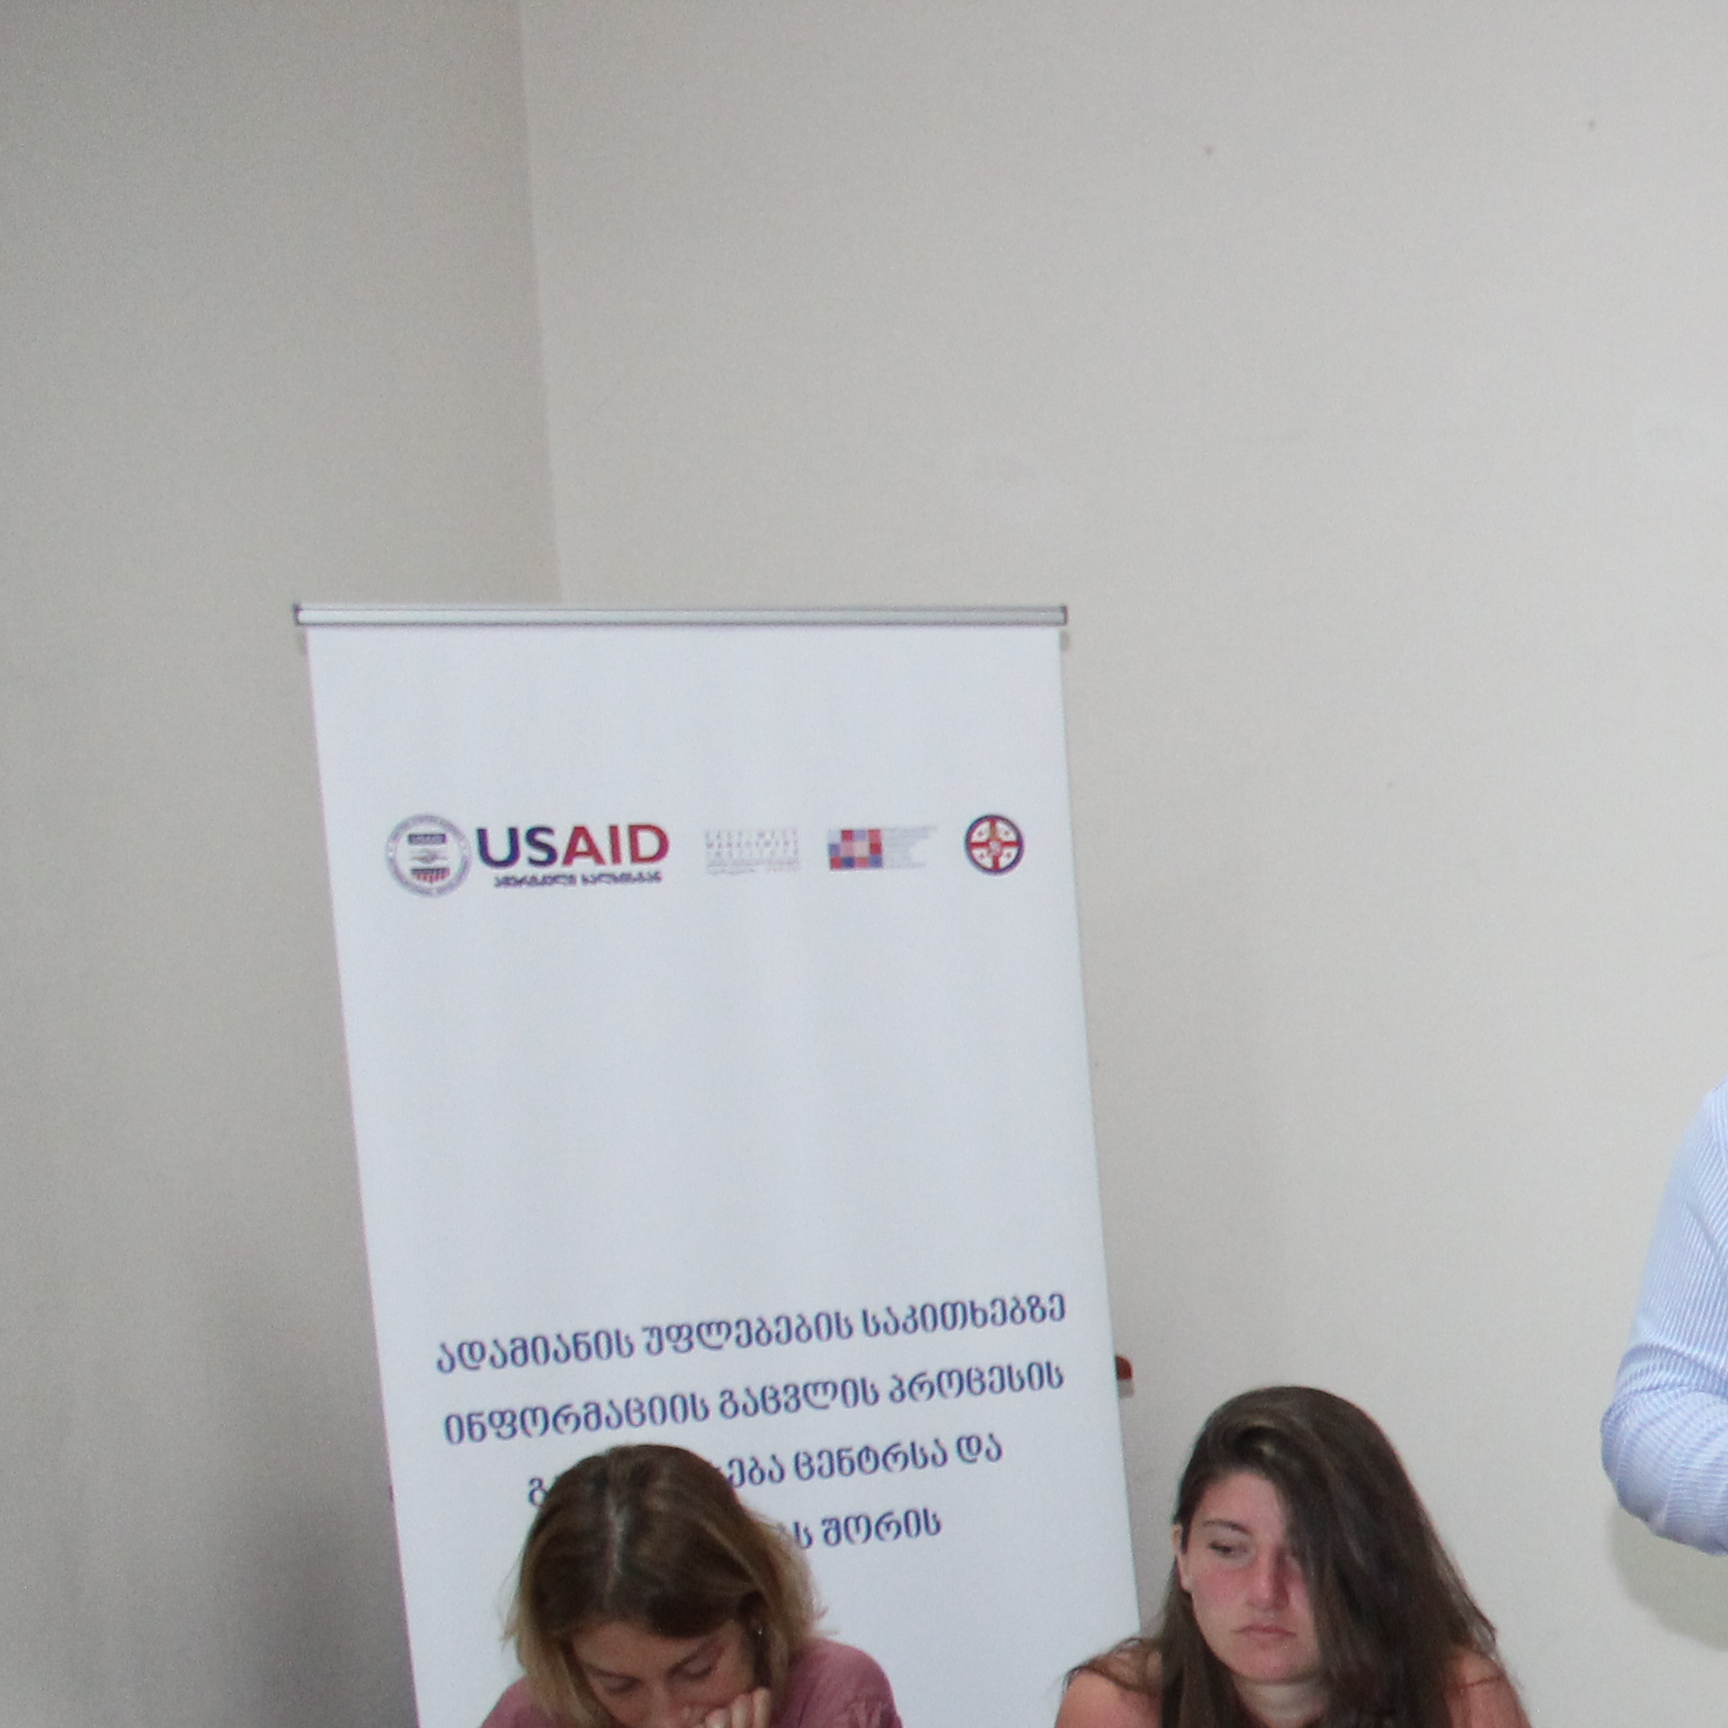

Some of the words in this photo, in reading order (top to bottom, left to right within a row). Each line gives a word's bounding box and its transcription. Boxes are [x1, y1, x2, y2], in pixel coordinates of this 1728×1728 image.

[476, 823, 671, 869] USAID
[436, 1328, 635, 1374] ადამიანის
[641, 1310, 854, 1356] უფლებების
[861, 1292, 1066, 1338] საკითხებზე
[444, 1392, 710, 1445] ინფორმაციის
[718, 1376, 880, 1420] გაცვლის
[888, 1360, 1065, 1404] პროცესის
[793, 1437, 949, 1481] ცენტრსა
[955, 1432, 1003, 1464] და
[820, 1507, 942, 1547] შორის
